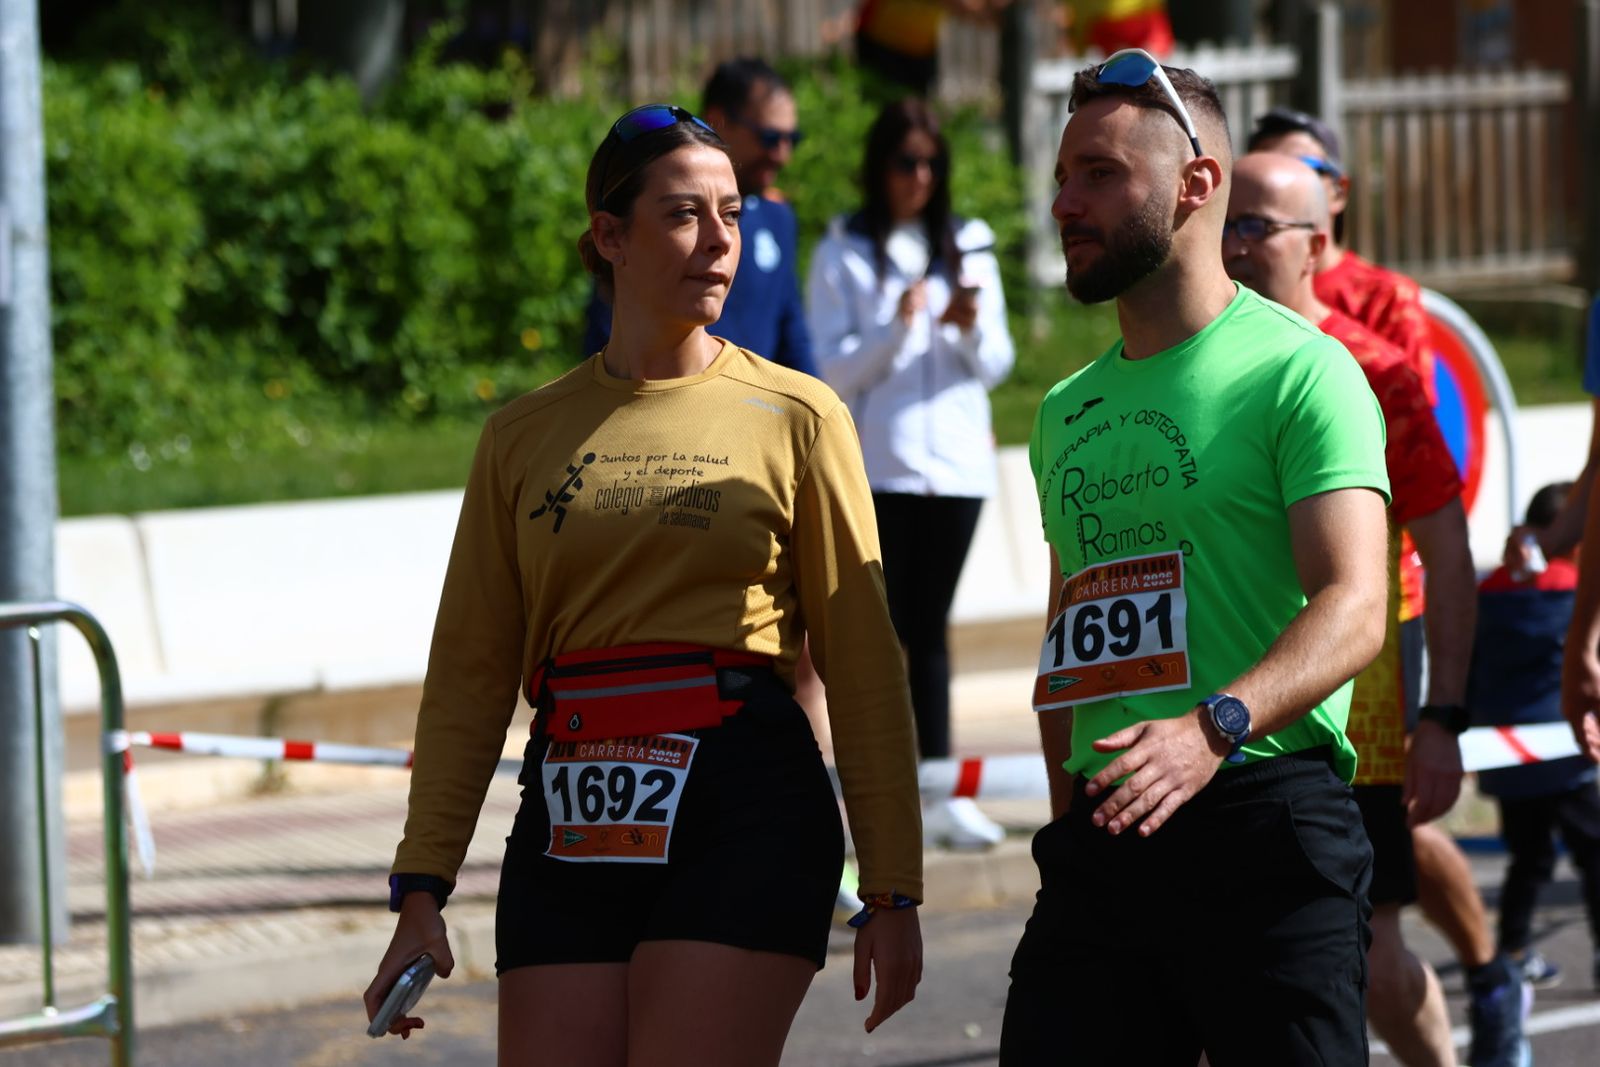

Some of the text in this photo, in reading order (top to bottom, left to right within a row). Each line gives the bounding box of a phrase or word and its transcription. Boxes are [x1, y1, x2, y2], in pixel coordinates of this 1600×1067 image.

[600, 453, 641, 463] Juntos
[645, 453, 668, 468] por
[692, 453, 729, 466] salud
[1119, 411, 1132, 427] Y
[1134, 409, 1199, 490] OSTEOPATIA
[624, 465, 705, 480] y el deporte
[1061, 463, 1170, 516] Roberto
[594, 479, 645, 515] colegio
[662, 479, 721, 512] médicos
[1079, 512, 1167, 558] Ramos
[1075, 576, 1140, 600] CARRERA
[1048, 593, 1174, 668] 1691
[579, 744, 645, 760] CARRERA
[551, 765, 677, 823] 1692
